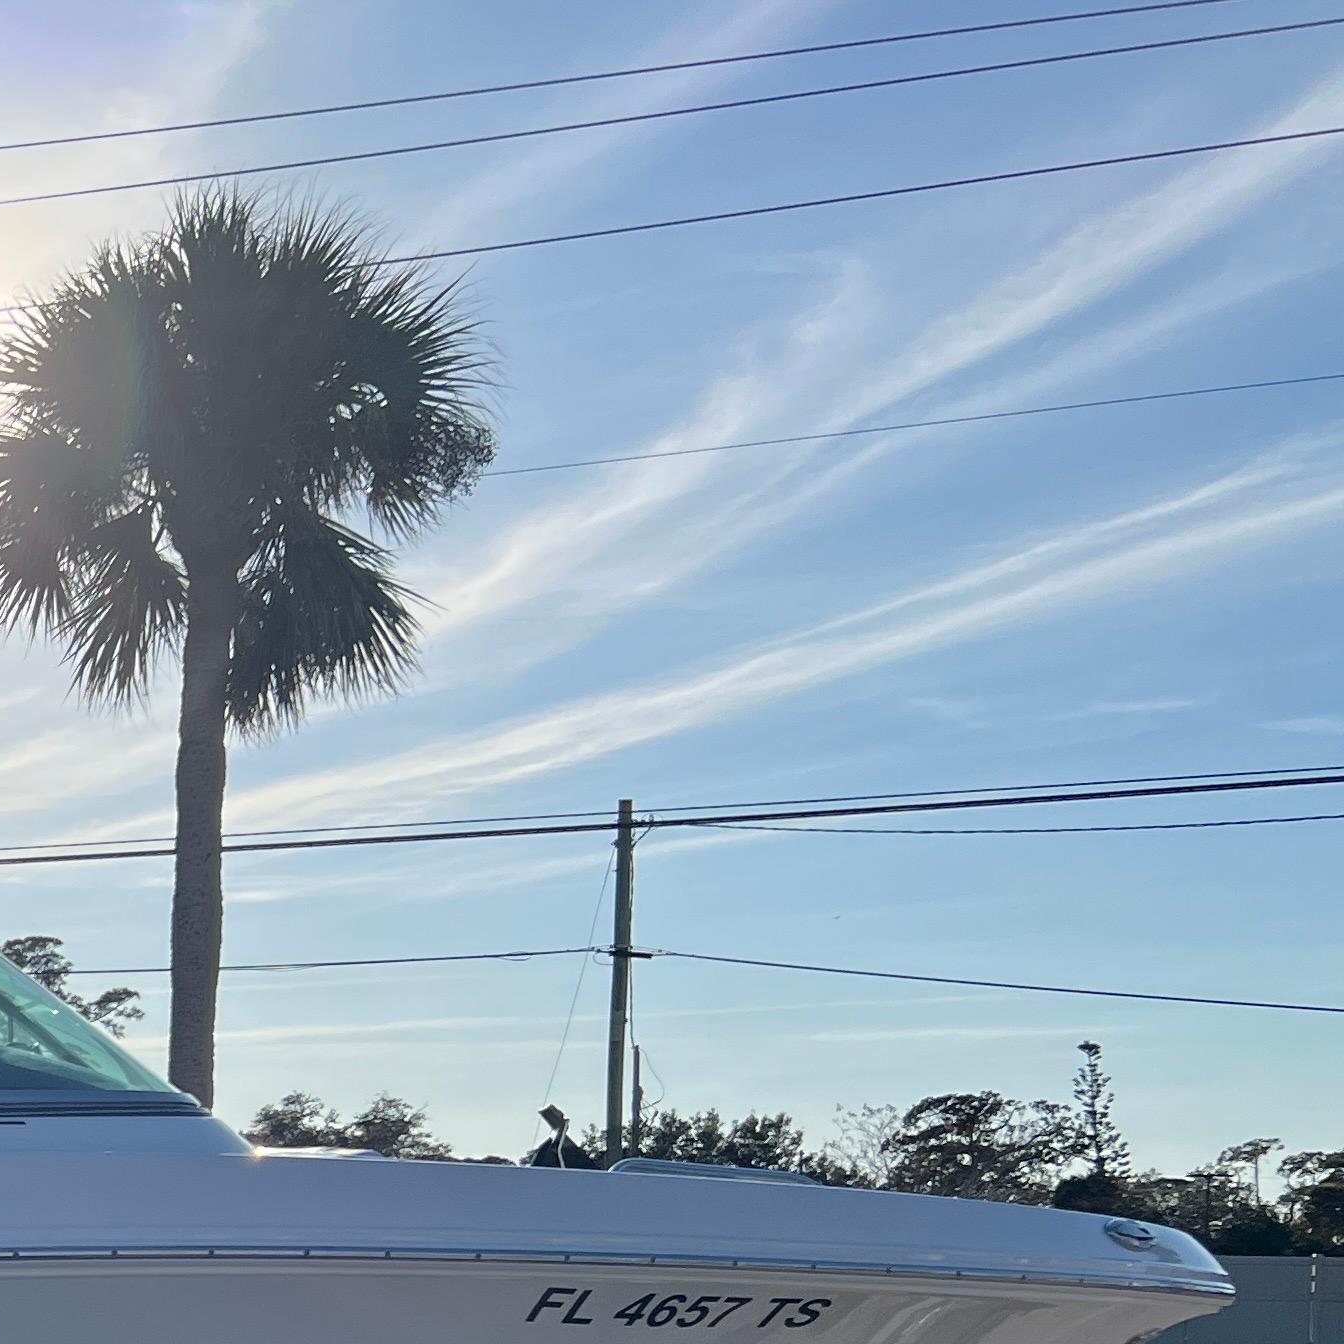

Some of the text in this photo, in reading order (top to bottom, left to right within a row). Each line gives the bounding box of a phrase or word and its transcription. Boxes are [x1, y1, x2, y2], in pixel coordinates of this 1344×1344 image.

[525, 1287, 832, 1328] FL 4657 TS
